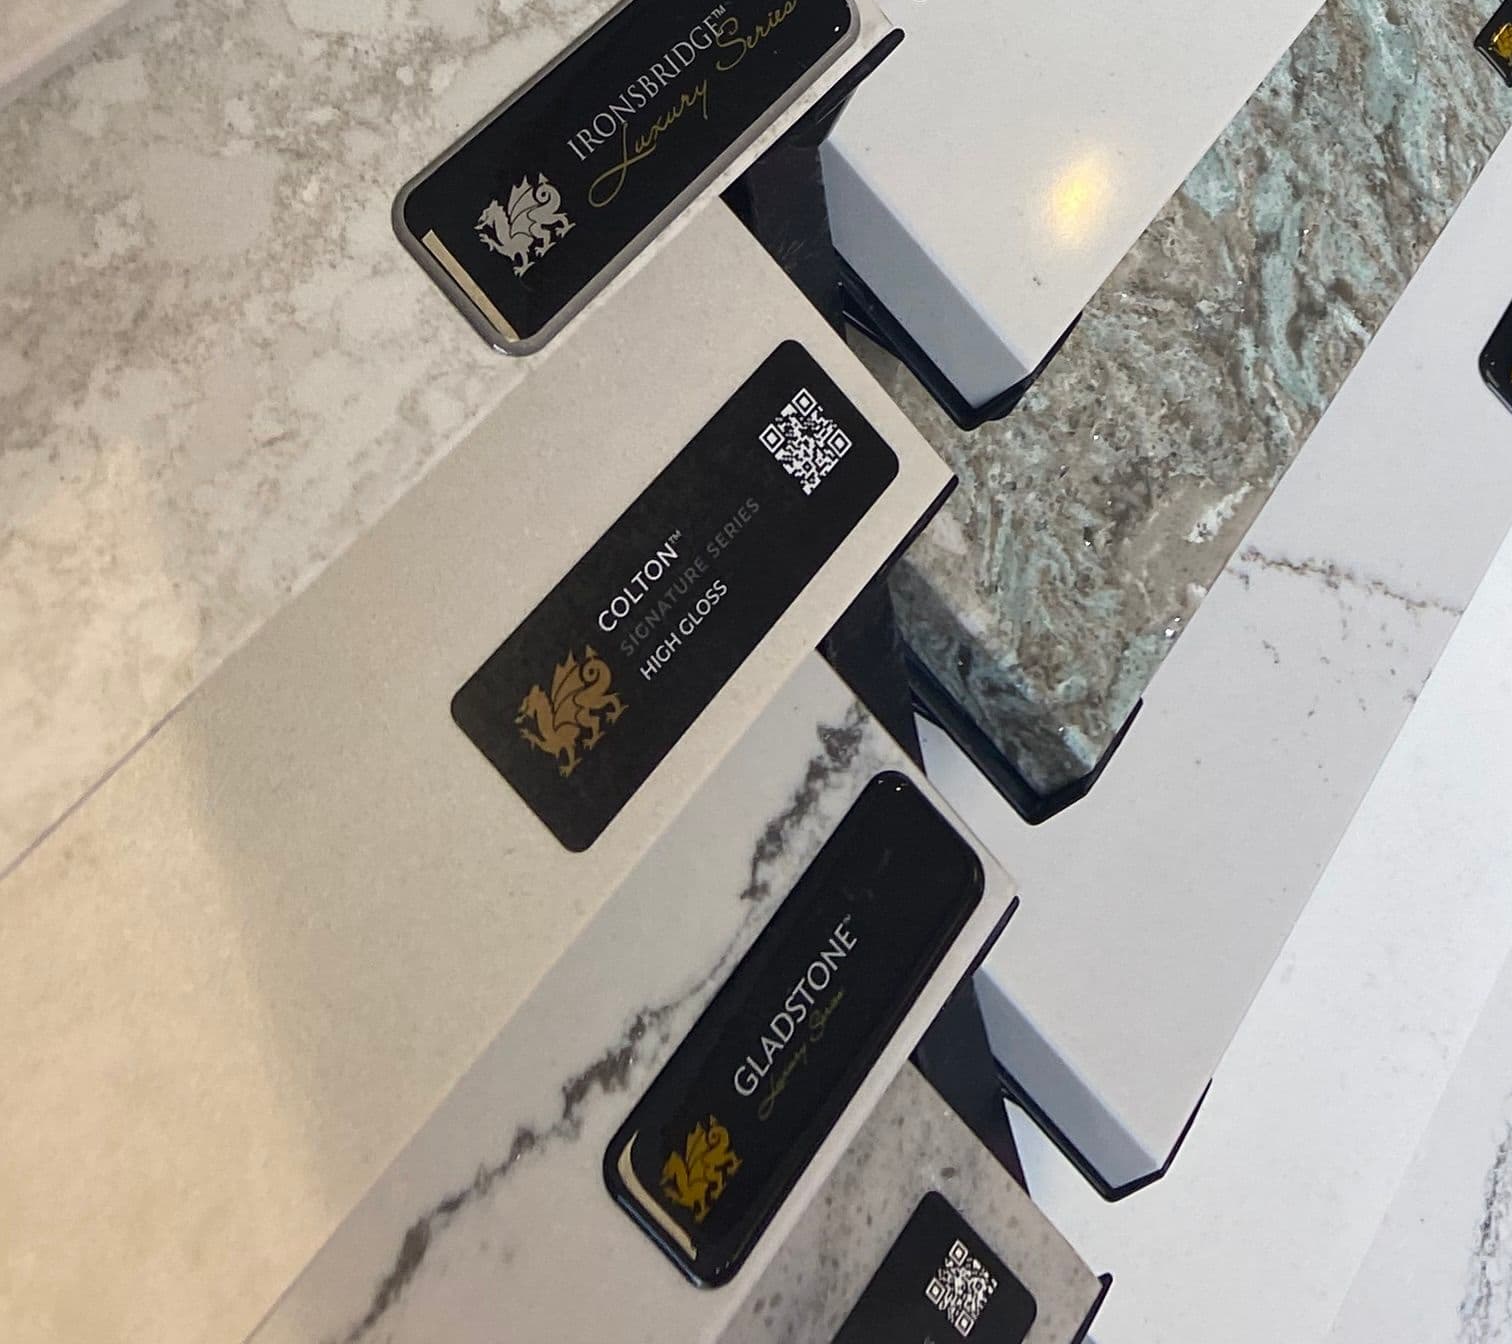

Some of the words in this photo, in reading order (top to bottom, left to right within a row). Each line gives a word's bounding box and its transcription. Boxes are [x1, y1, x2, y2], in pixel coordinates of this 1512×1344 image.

[588, 79, 710, 208] Luxury
[620, 557, 709, 658] SIGNATURE
[706, 496, 761, 560] SERIES
[639, 630, 683, 683] HIGH
[679, 579, 729, 638] GLOSS
